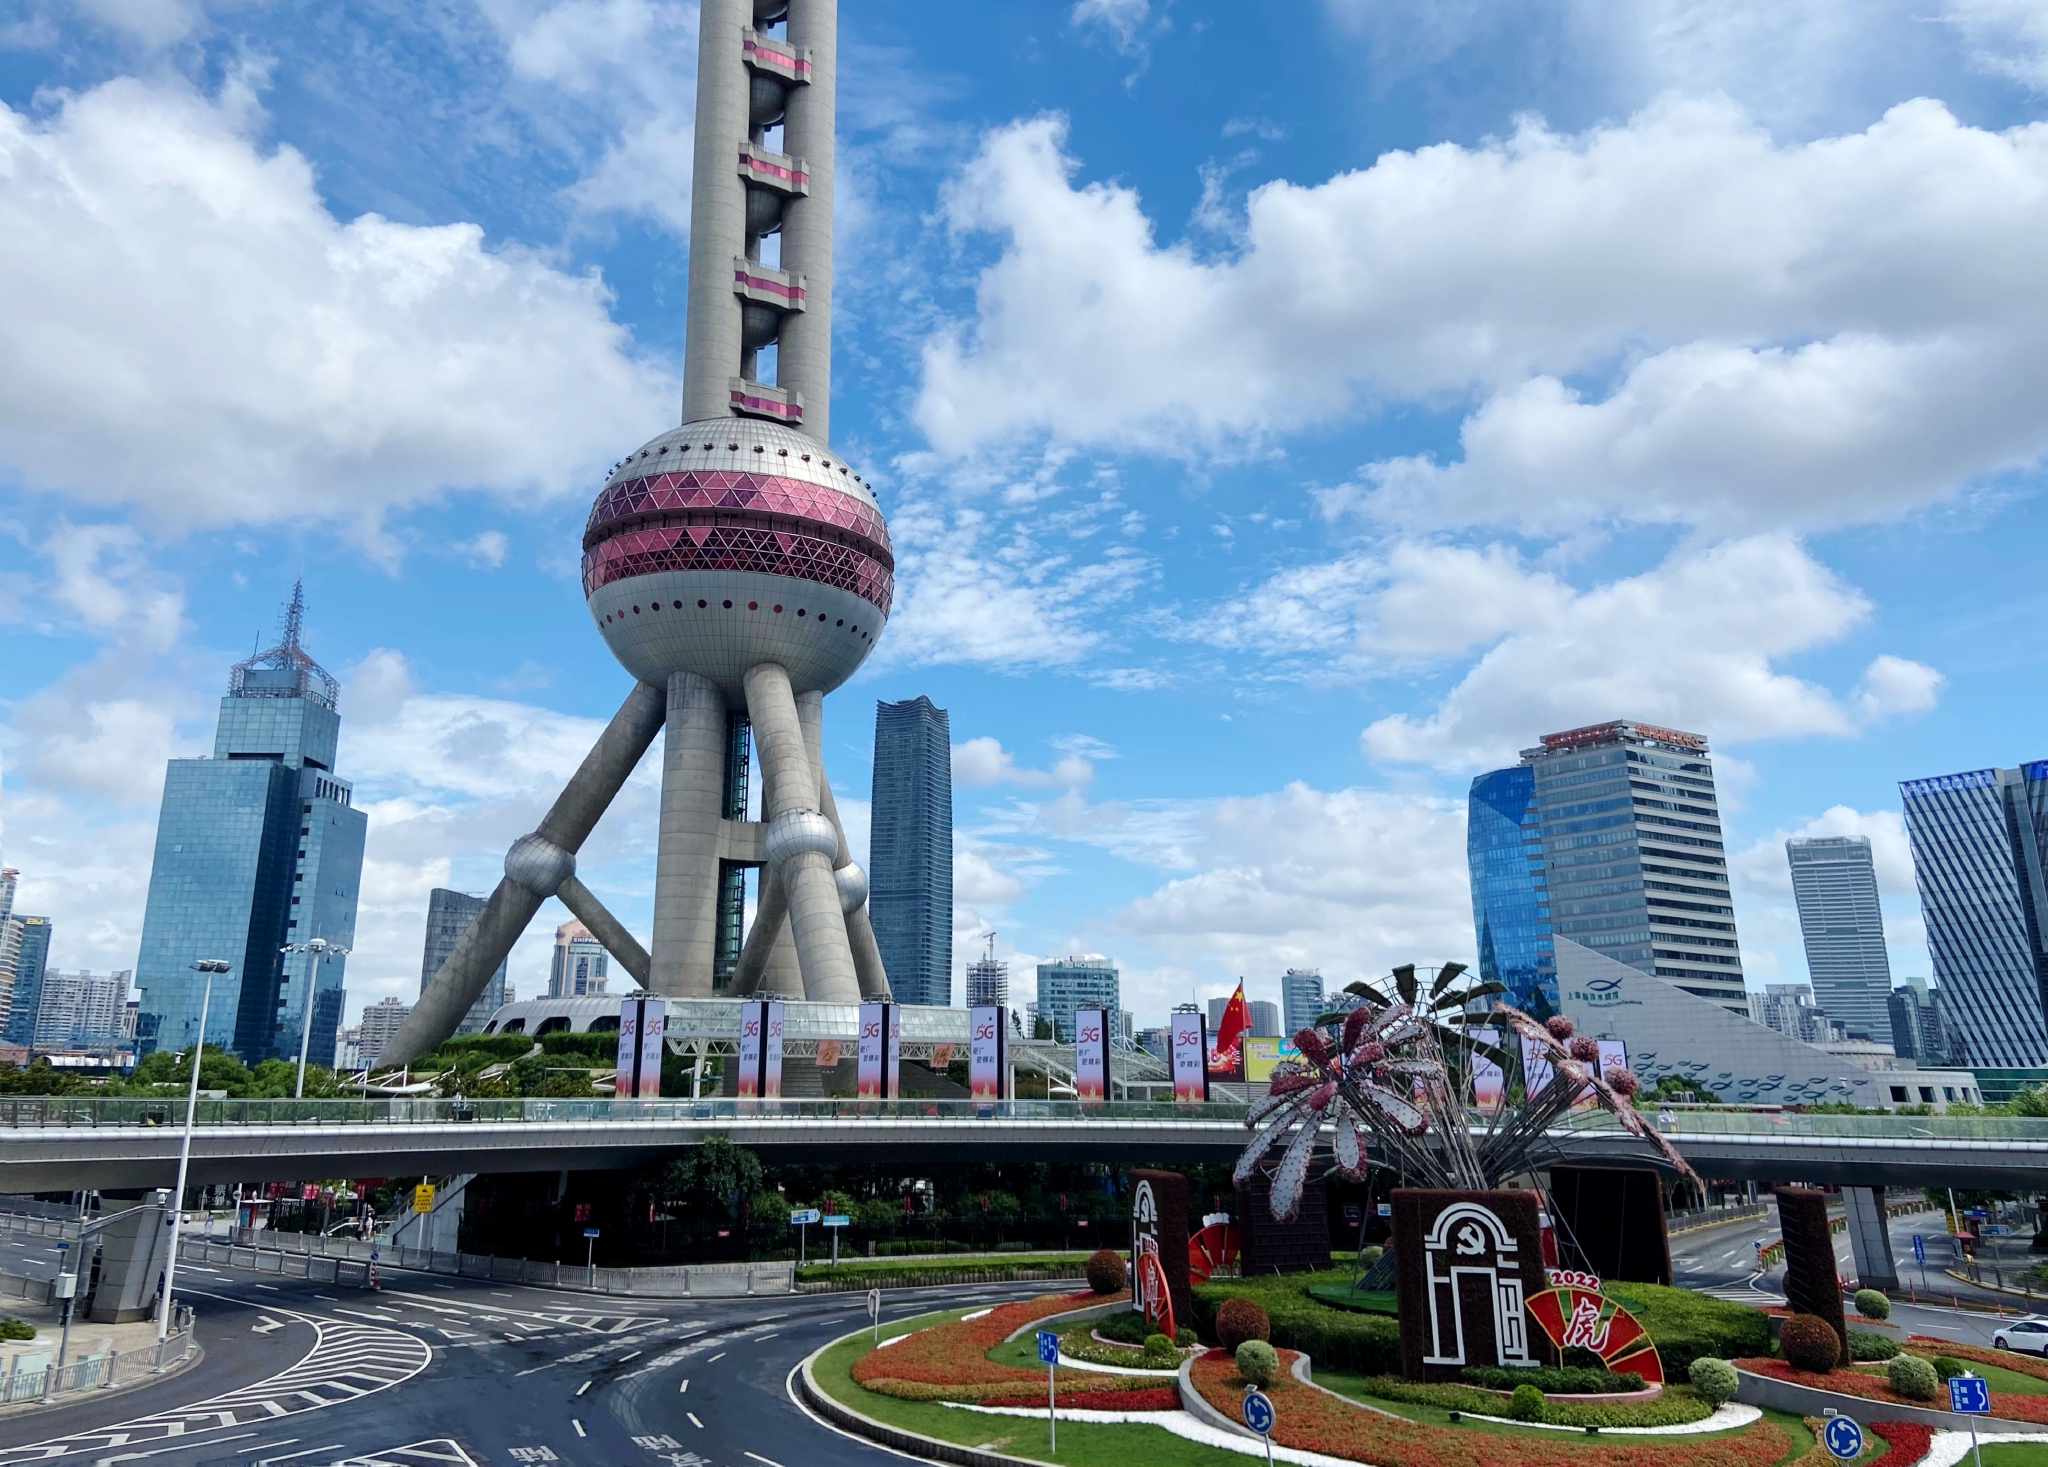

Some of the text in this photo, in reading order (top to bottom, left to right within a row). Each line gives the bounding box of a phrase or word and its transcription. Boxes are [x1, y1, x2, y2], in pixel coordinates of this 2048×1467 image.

[621, 1018, 635, 1036] 5G
[645, 1018, 661, 1036] 5G
[743, 1020, 759, 1037] 5G
[769, 1020, 782, 1037] 5G
[861, 1021, 880, 1039] 5G
[974, 1024, 994, 1041] 5G
[1079, 1026, 1100, 1043] 5G
[1176, 1030, 1198, 1046] 5G
[1603, 1053, 1623, 1066] 5G
[1550, 1270, 1600, 1290] 2022
[1563, 1296, 1610, 1352] 虎
